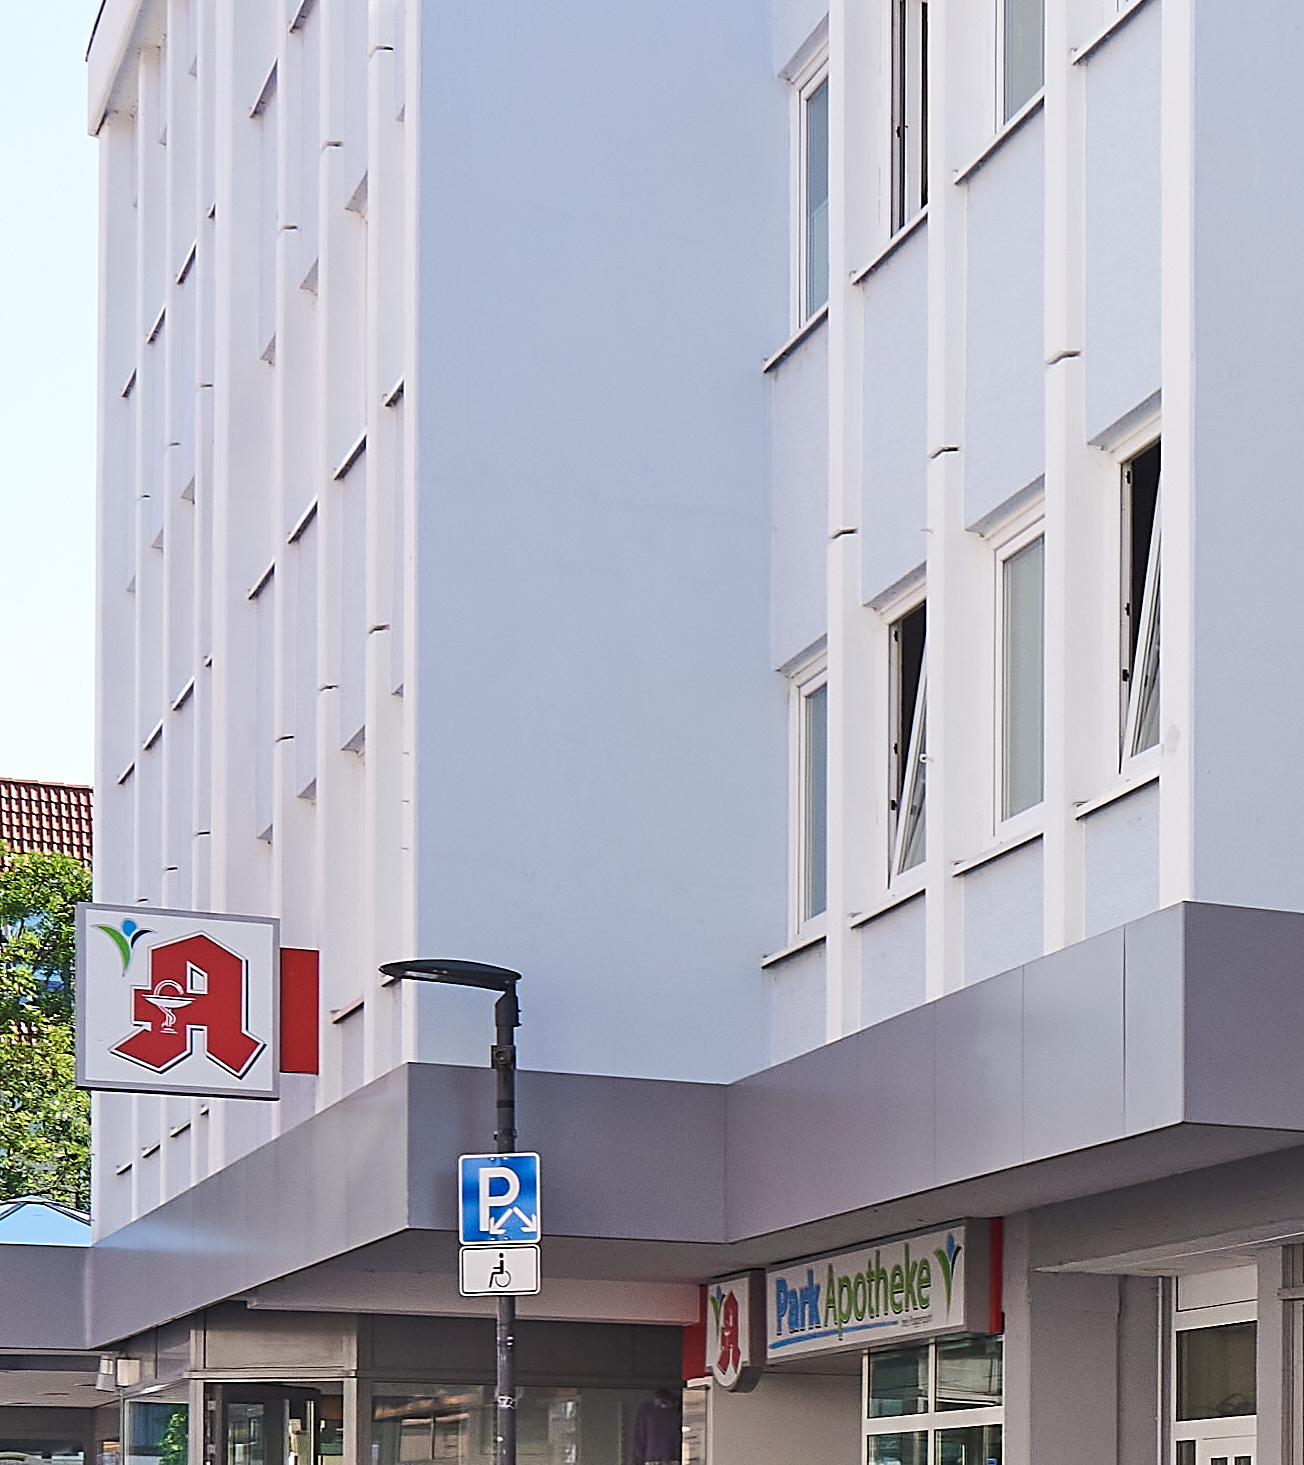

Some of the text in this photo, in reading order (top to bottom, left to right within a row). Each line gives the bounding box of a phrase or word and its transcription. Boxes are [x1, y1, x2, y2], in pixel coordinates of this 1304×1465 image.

[479, 1166, 520, 1232] P
[776, 1242, 932, 1341] Park Apotheke
